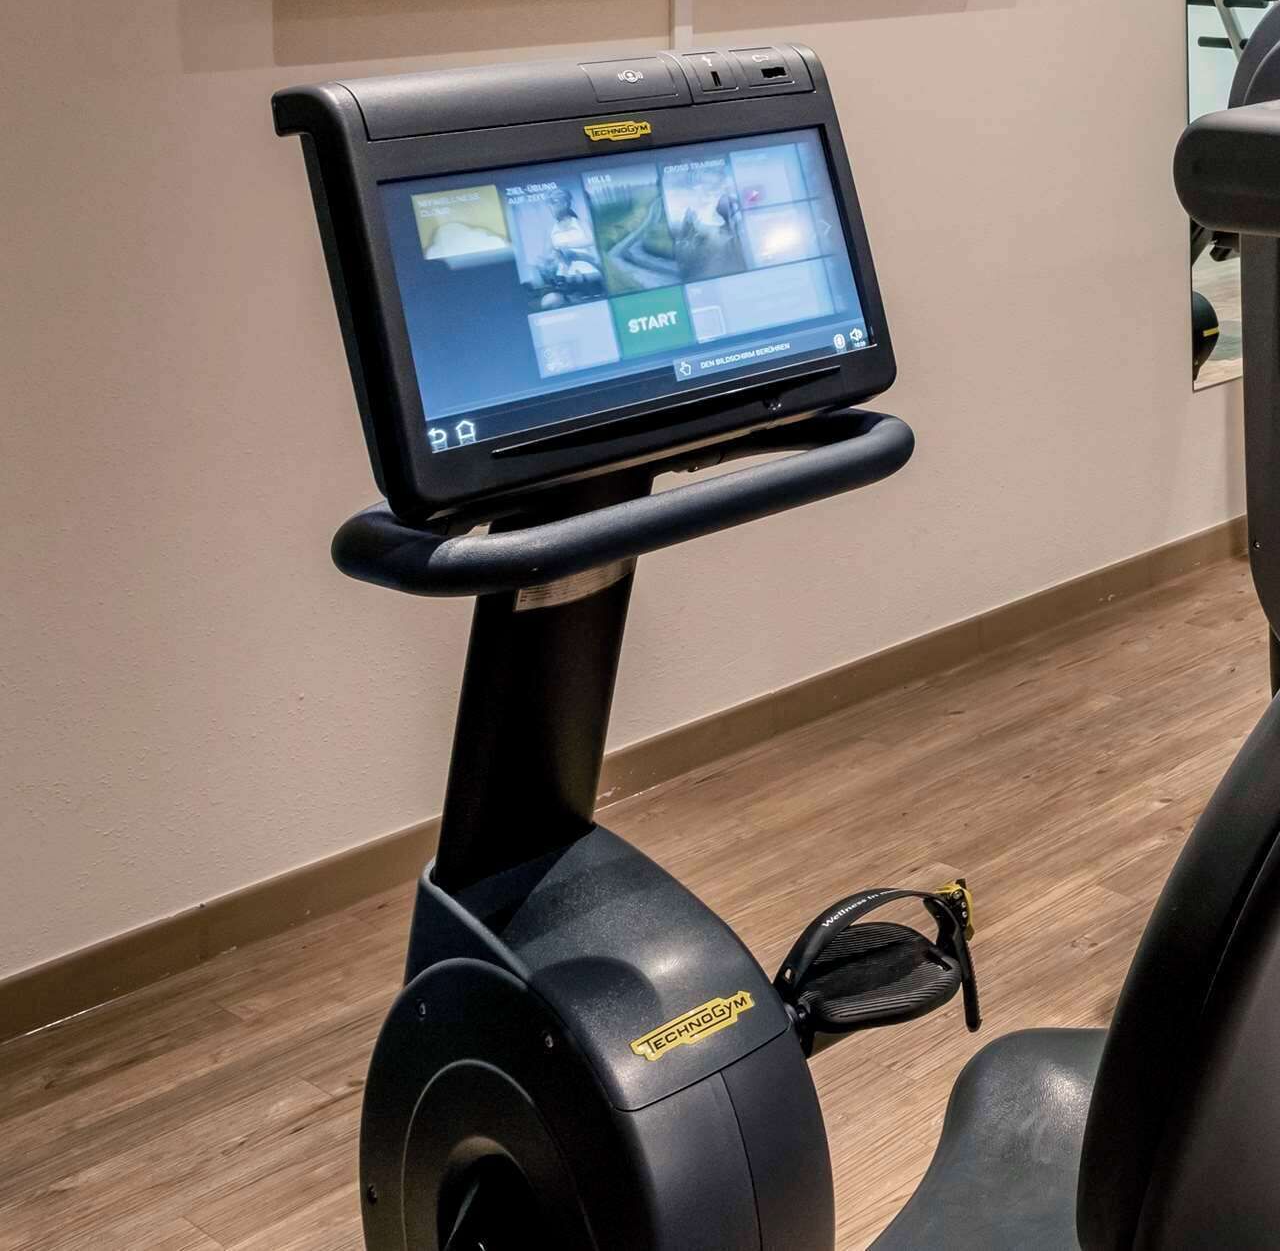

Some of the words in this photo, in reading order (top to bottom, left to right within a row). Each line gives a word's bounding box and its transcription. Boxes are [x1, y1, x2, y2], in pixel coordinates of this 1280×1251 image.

[585, 123, 649, 138] TECHNOGYM
[627, 310, 678, 334] START
[821, 898, 867, 928] Wellness
[636, 996, 748, 1054] TECHNOGYM
